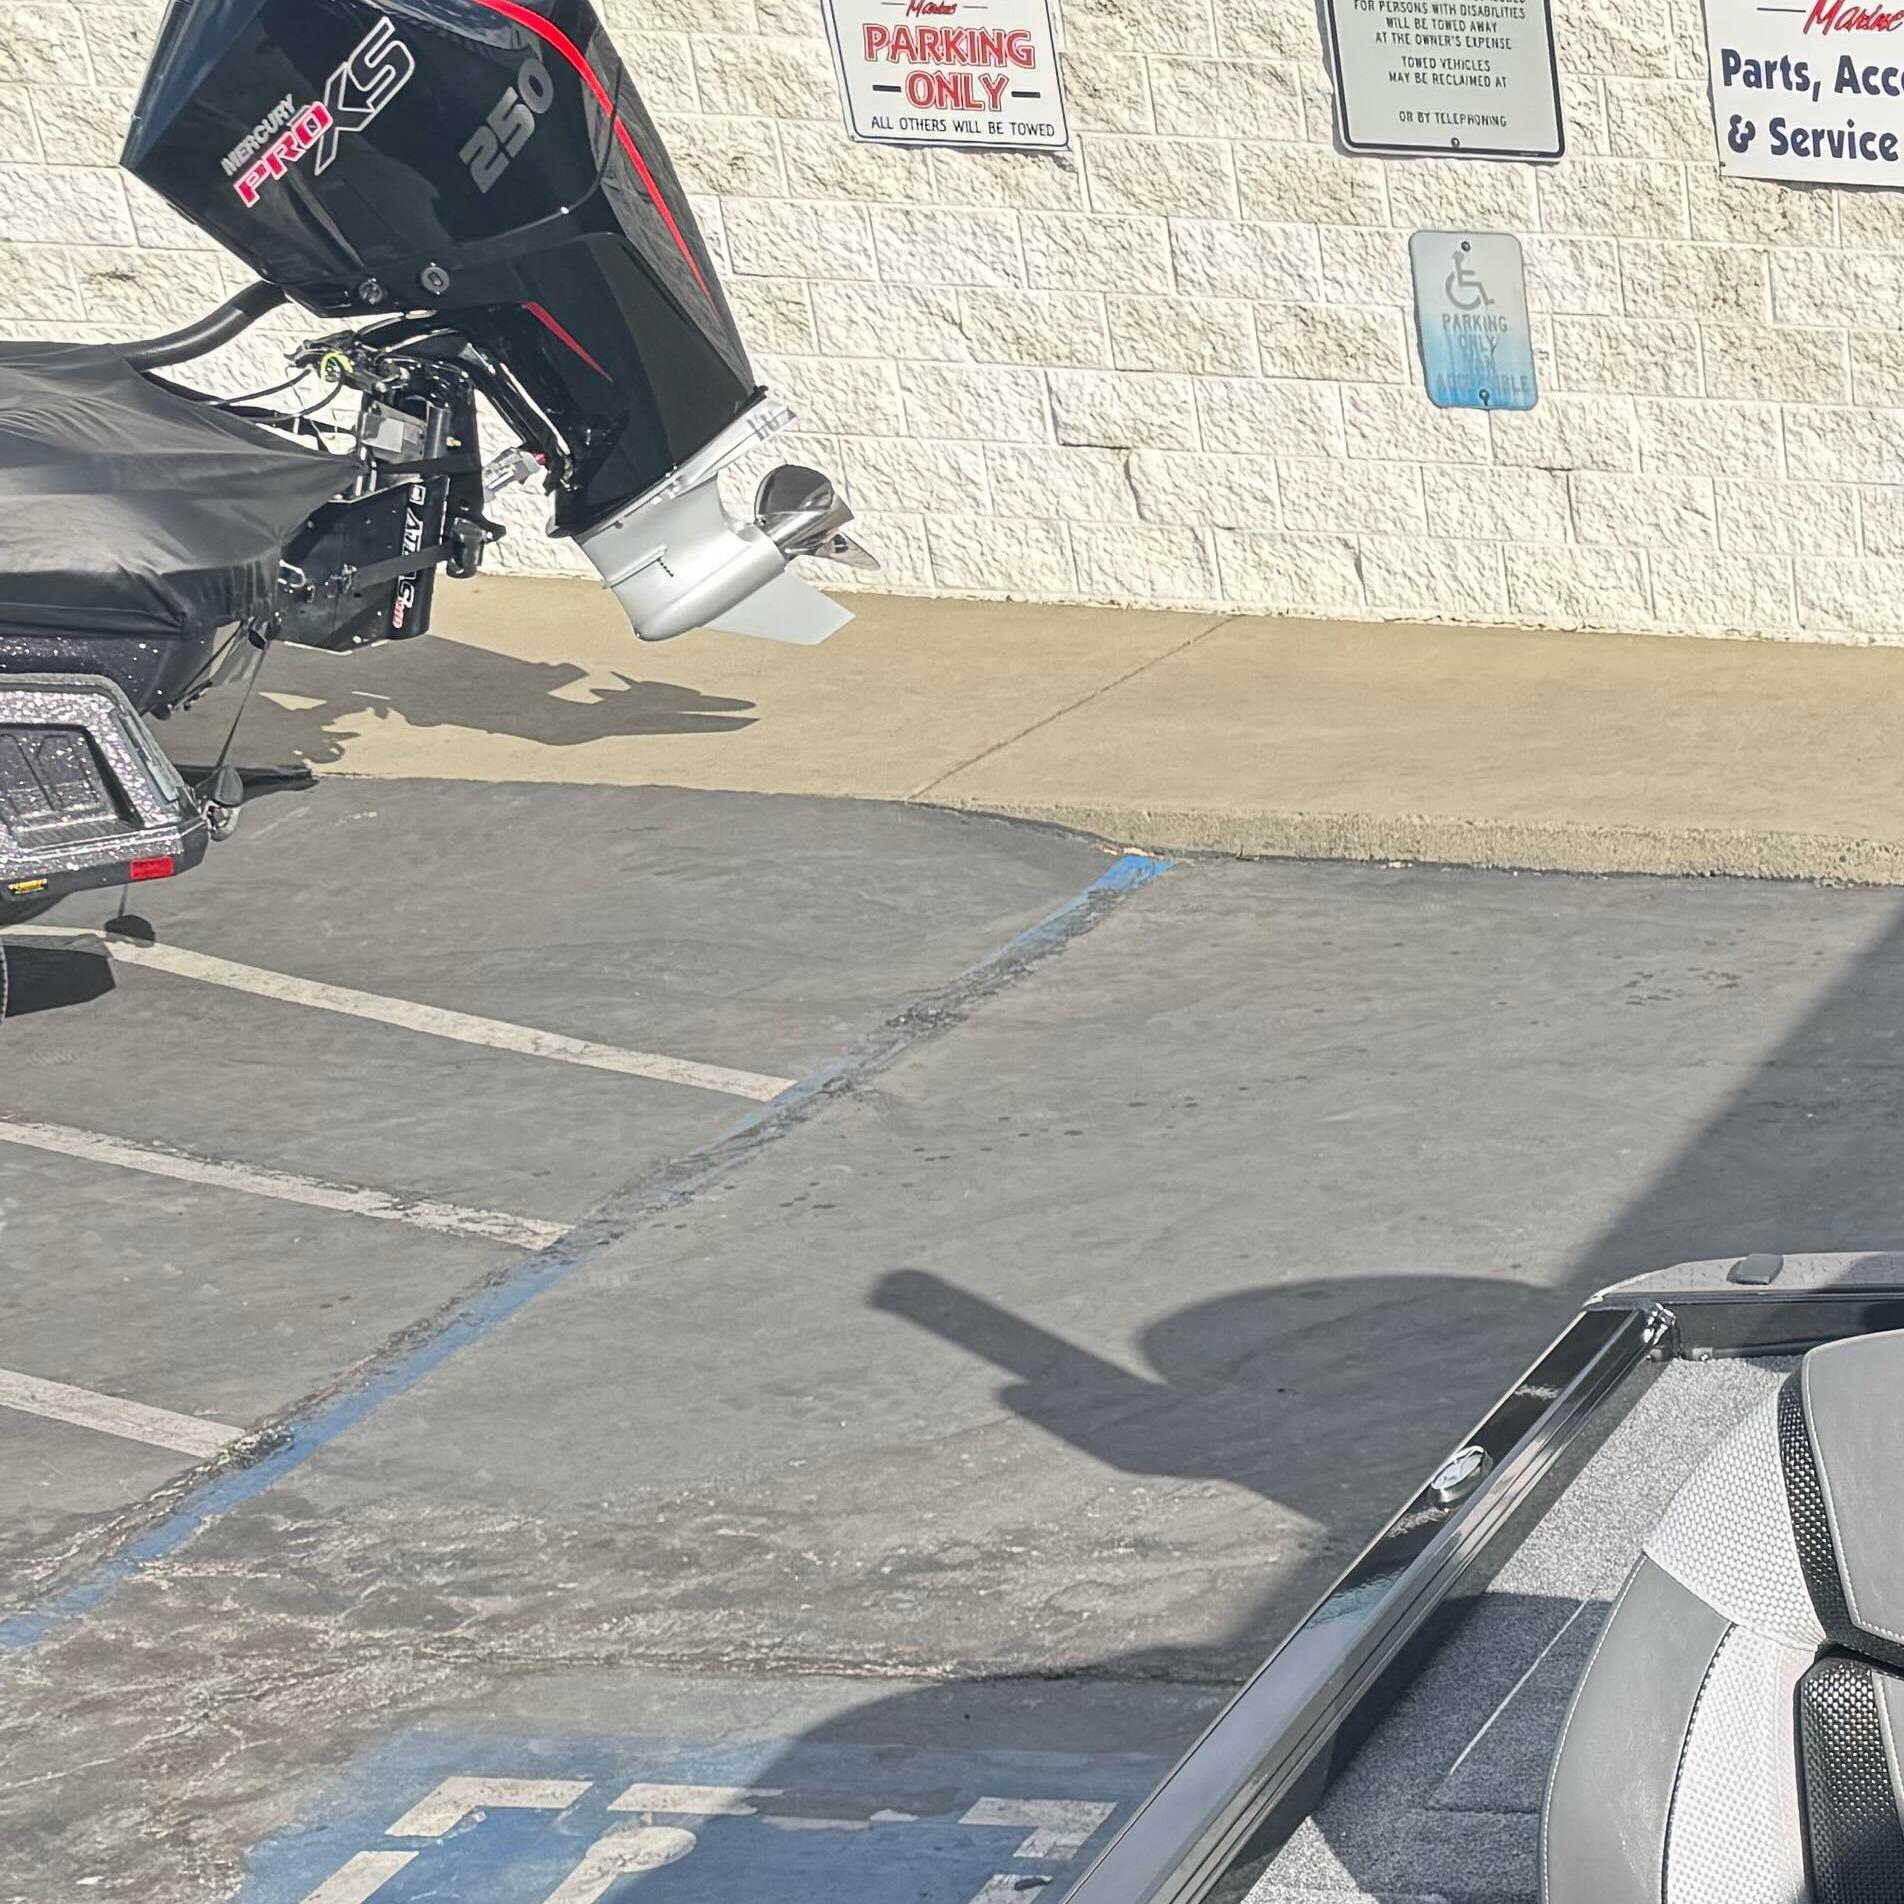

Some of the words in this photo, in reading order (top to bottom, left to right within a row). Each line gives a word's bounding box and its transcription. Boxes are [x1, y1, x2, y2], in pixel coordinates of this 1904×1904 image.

[1379, 2, 1428, 15] PERSONS
[1432, 4, 1457, 16] WITH
[1460, 5, 1526, 20] DISABILITIES
[1386, 17, 1410, 30] WILL
[1415, 18, 1428, 30] BE
[1432, 19, 1466, 32] TOWED
[1470, 21, 1497, 33] AWAY
[862, 23, 1036, 70] PARKING
[1375, 32, 1387, 44] AT
[1391, 33, 1411, 46] THE
[1415, 34, 1461, 48] OWNER'S
[1466, 36, 1512, 50] EXPENSE
[1401, 56, 1437, 70] TOWED
[1440, 58, 1490, 72] VEHICLES
[1389, 72, 1409, 84] MAY
[1415, 73, 1428, 85] BE
[1432, 73, 1491, 88] RECLAIMED
[1495, 76, 1507, 88] AT
[1721, 48, 1821, 102] Parts,
[905, 69, 1009, 112] ONLY
[459, 58, 554, 194] 250
[871, 116, 893, 130] ALL
[899, 117, 947, 132] OTHERS
[953, 120, 982, 135] WILL
[988, 121, 1003, 136] BE
[1010, 121, 1055, 138] TOWED
[1399, 111, 1413, 123] OR
[1418, 112, 1431, 124] BY
[1435, 112, 1507, 127] TELEPHONING
[221, 93, 296, 176] MERCURY
[1728, 114, 1756, 154] &
[1769, 117, 1899, 162] Service
[1441, 313, 1508, 333] PARKING
[1458, 333, 1497, 352] ONLY
